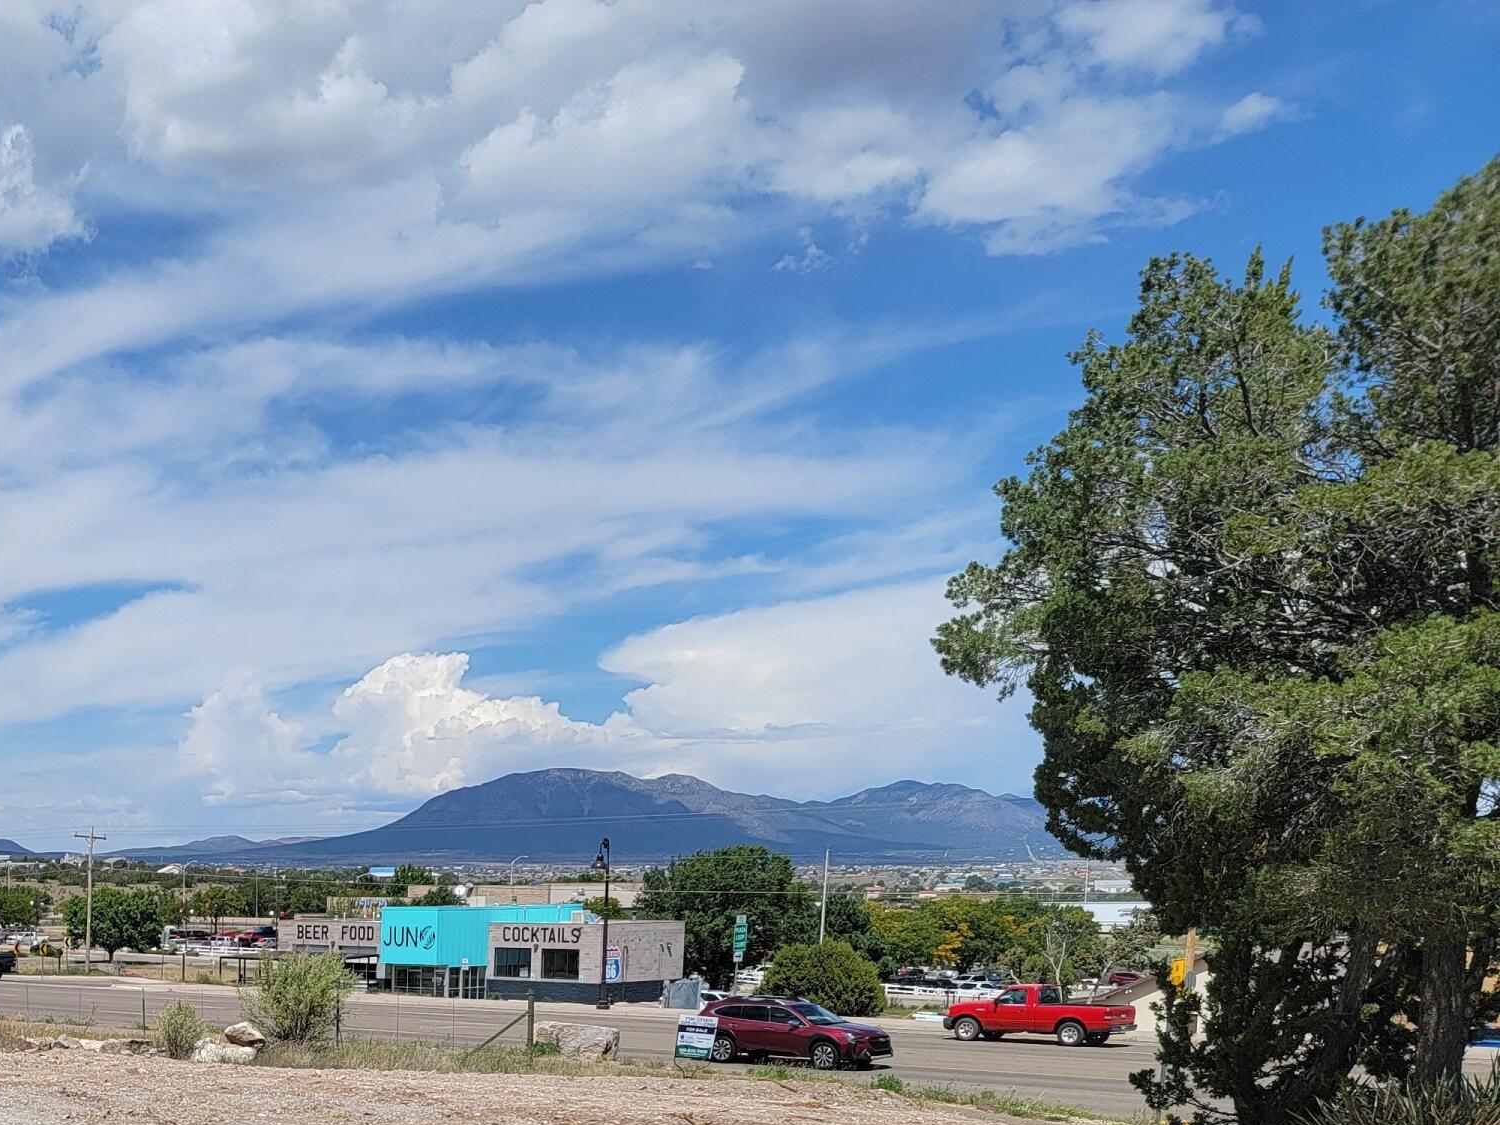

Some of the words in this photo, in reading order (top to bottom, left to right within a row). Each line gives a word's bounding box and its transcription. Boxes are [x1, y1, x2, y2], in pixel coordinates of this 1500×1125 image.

[297, 925, 329, 940] BEER
[341, 925, 374, 941] FOOD
[383, 925, 436, 950] JUNO
[502, 926, 583, 944] COCKTAILS
[606, 964, 617, 979] 66
